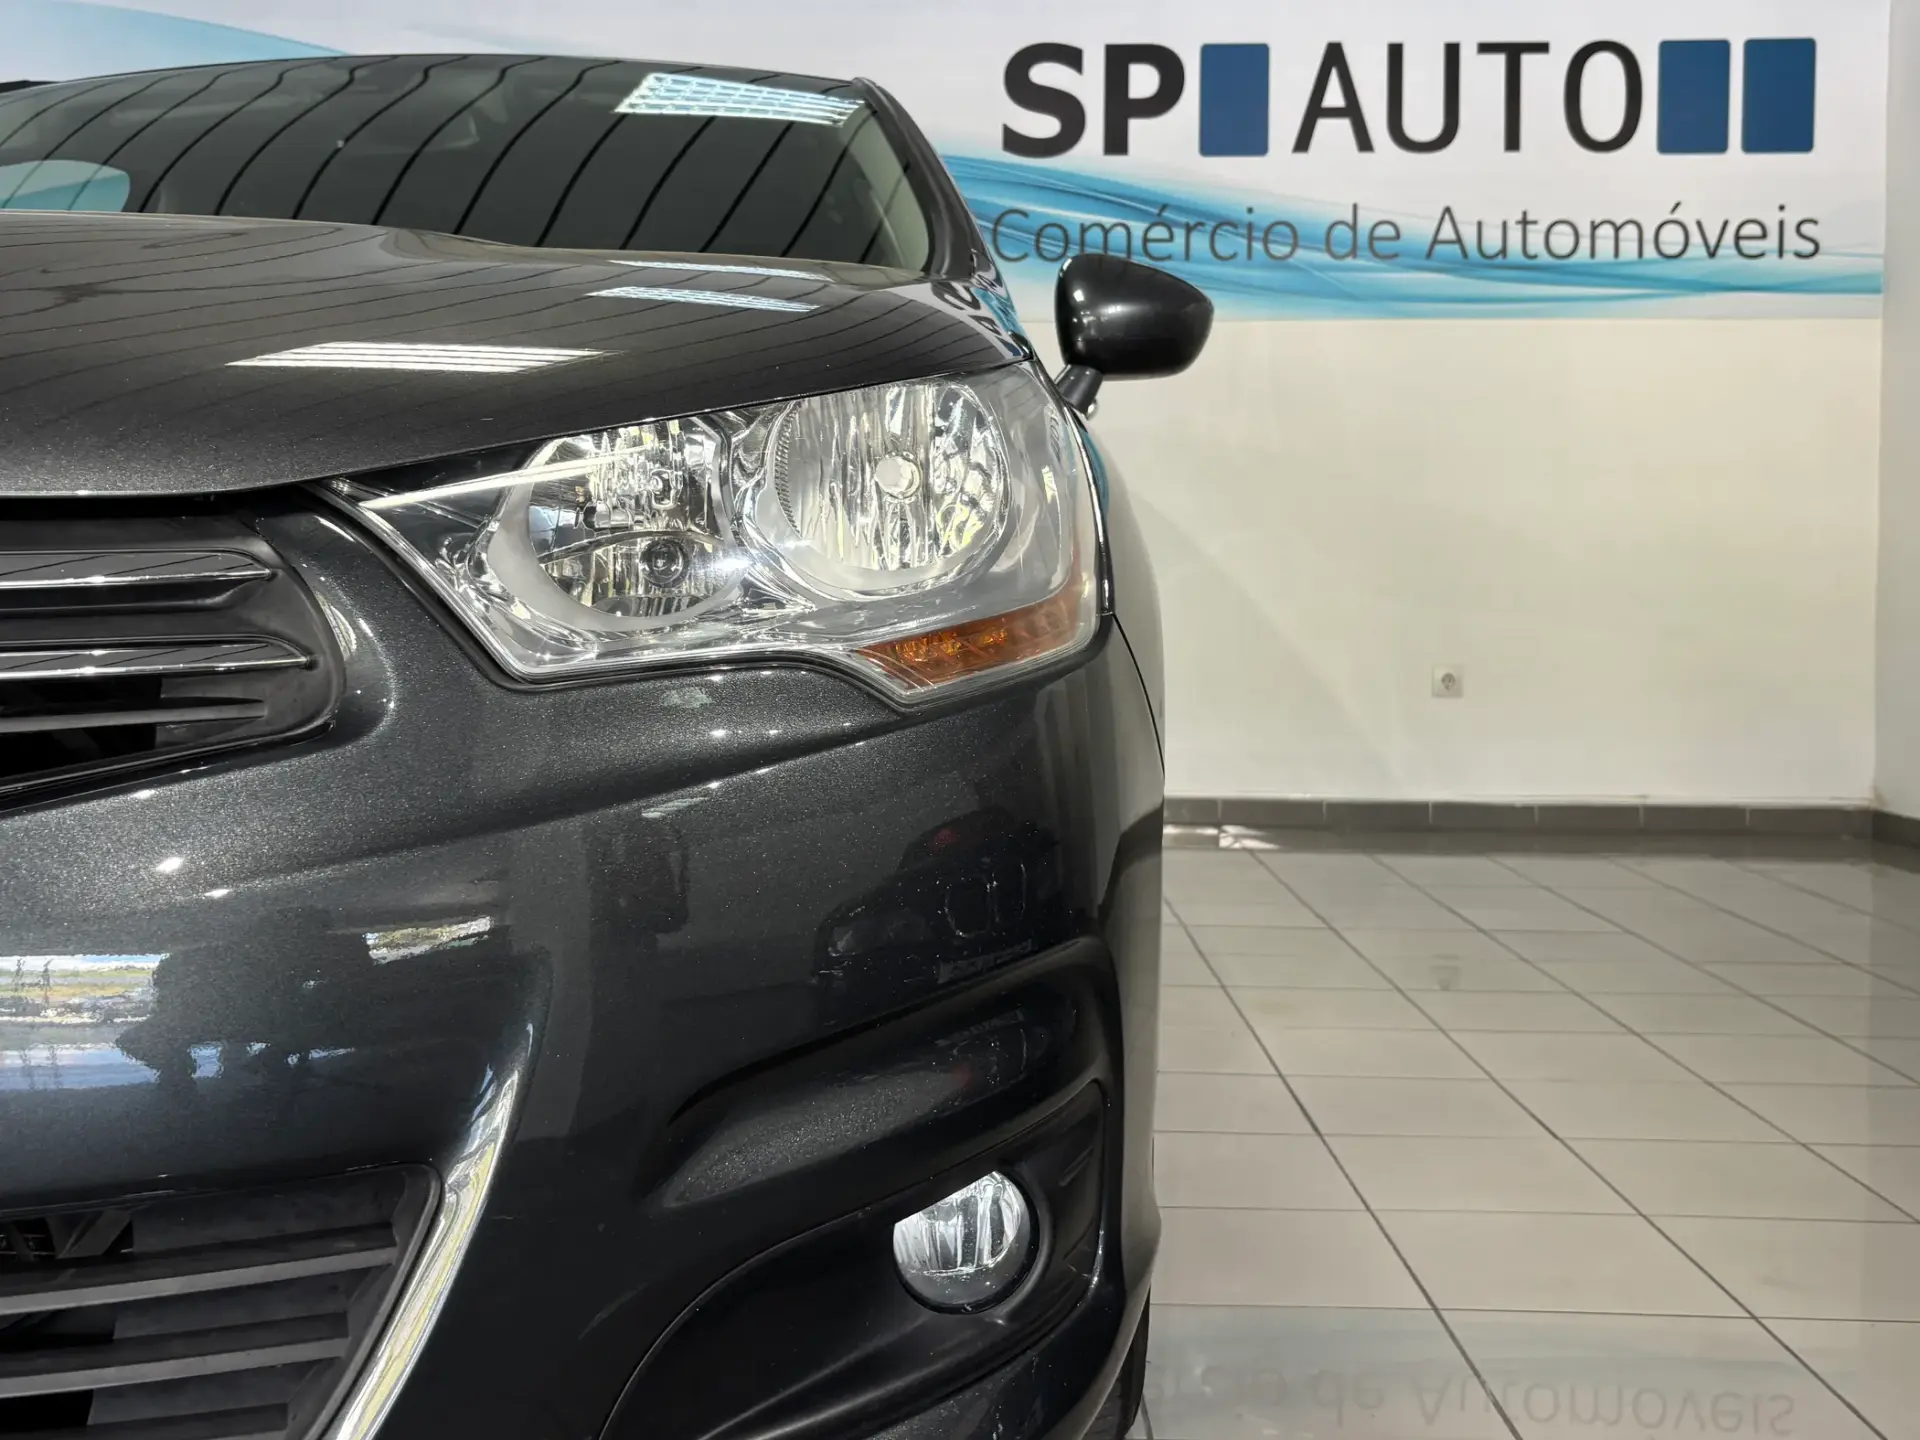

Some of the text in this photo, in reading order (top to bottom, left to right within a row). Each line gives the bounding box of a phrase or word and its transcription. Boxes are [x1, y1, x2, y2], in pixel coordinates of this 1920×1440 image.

[1002, 40, 1643, 159] SP AUTO
[991, 201, 1821, 263] Comércio de Automóveis
